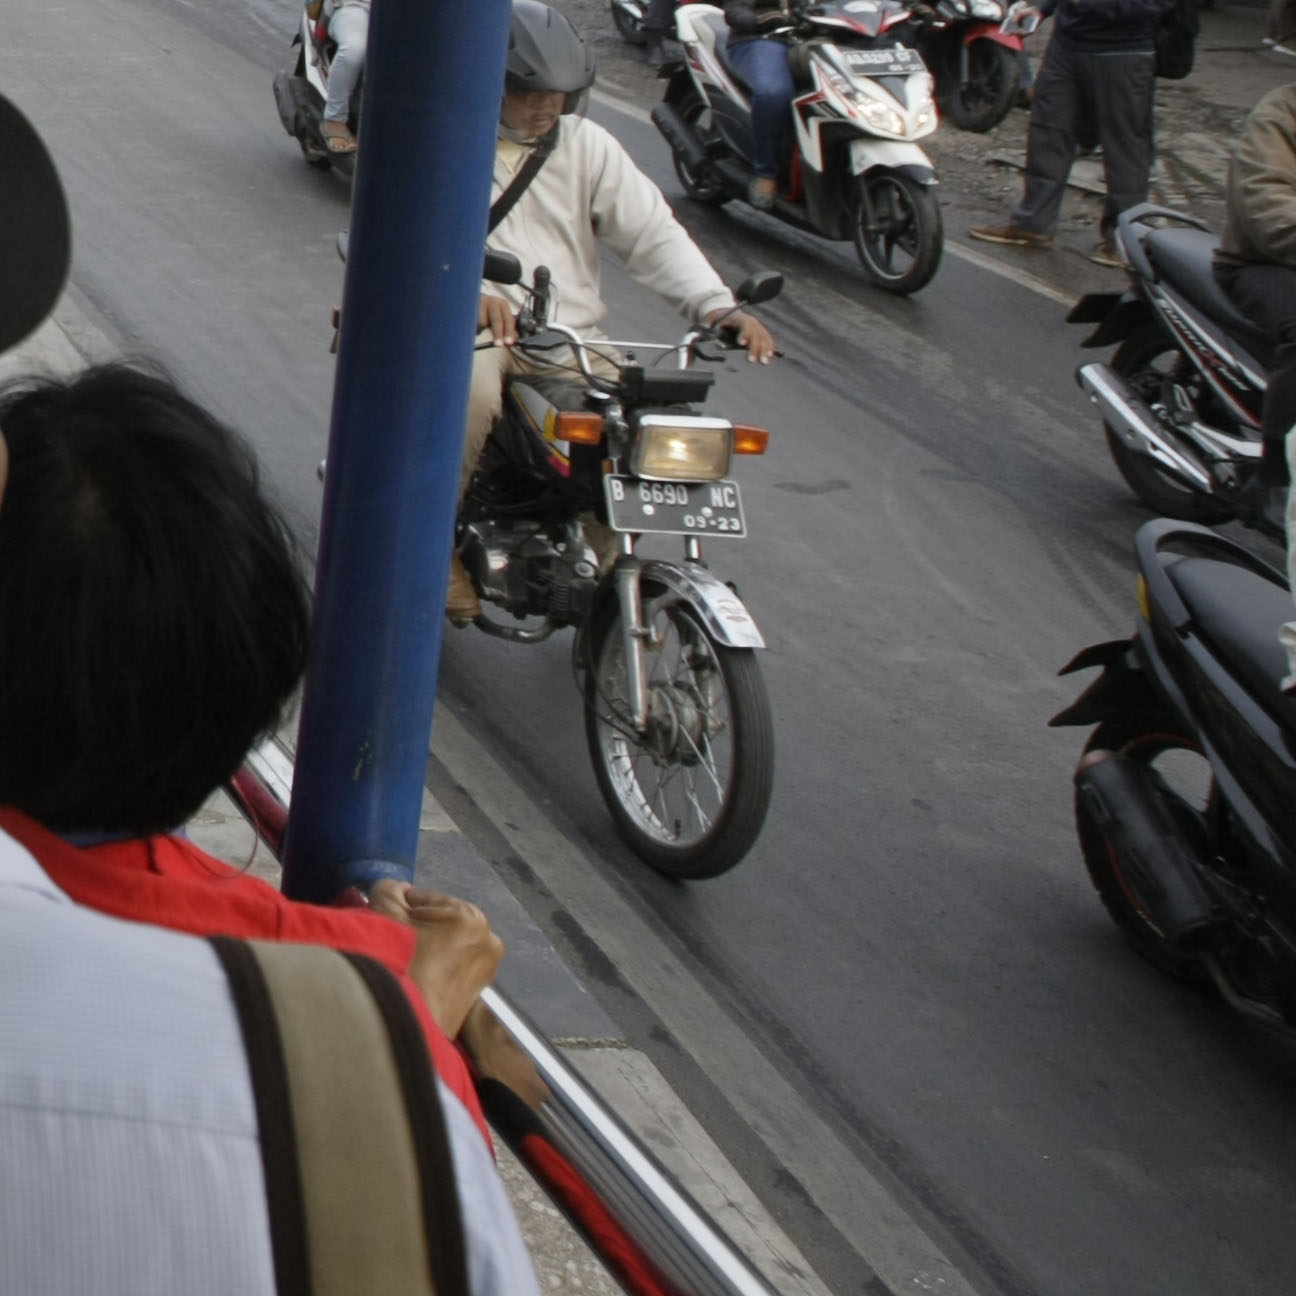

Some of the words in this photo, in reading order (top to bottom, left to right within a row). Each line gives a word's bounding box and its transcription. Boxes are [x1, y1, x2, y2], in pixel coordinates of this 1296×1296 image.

[611, 480, 625, 501] B
[639, 482, 689, 505] 6690
[710, 487, 736, 508] NC
